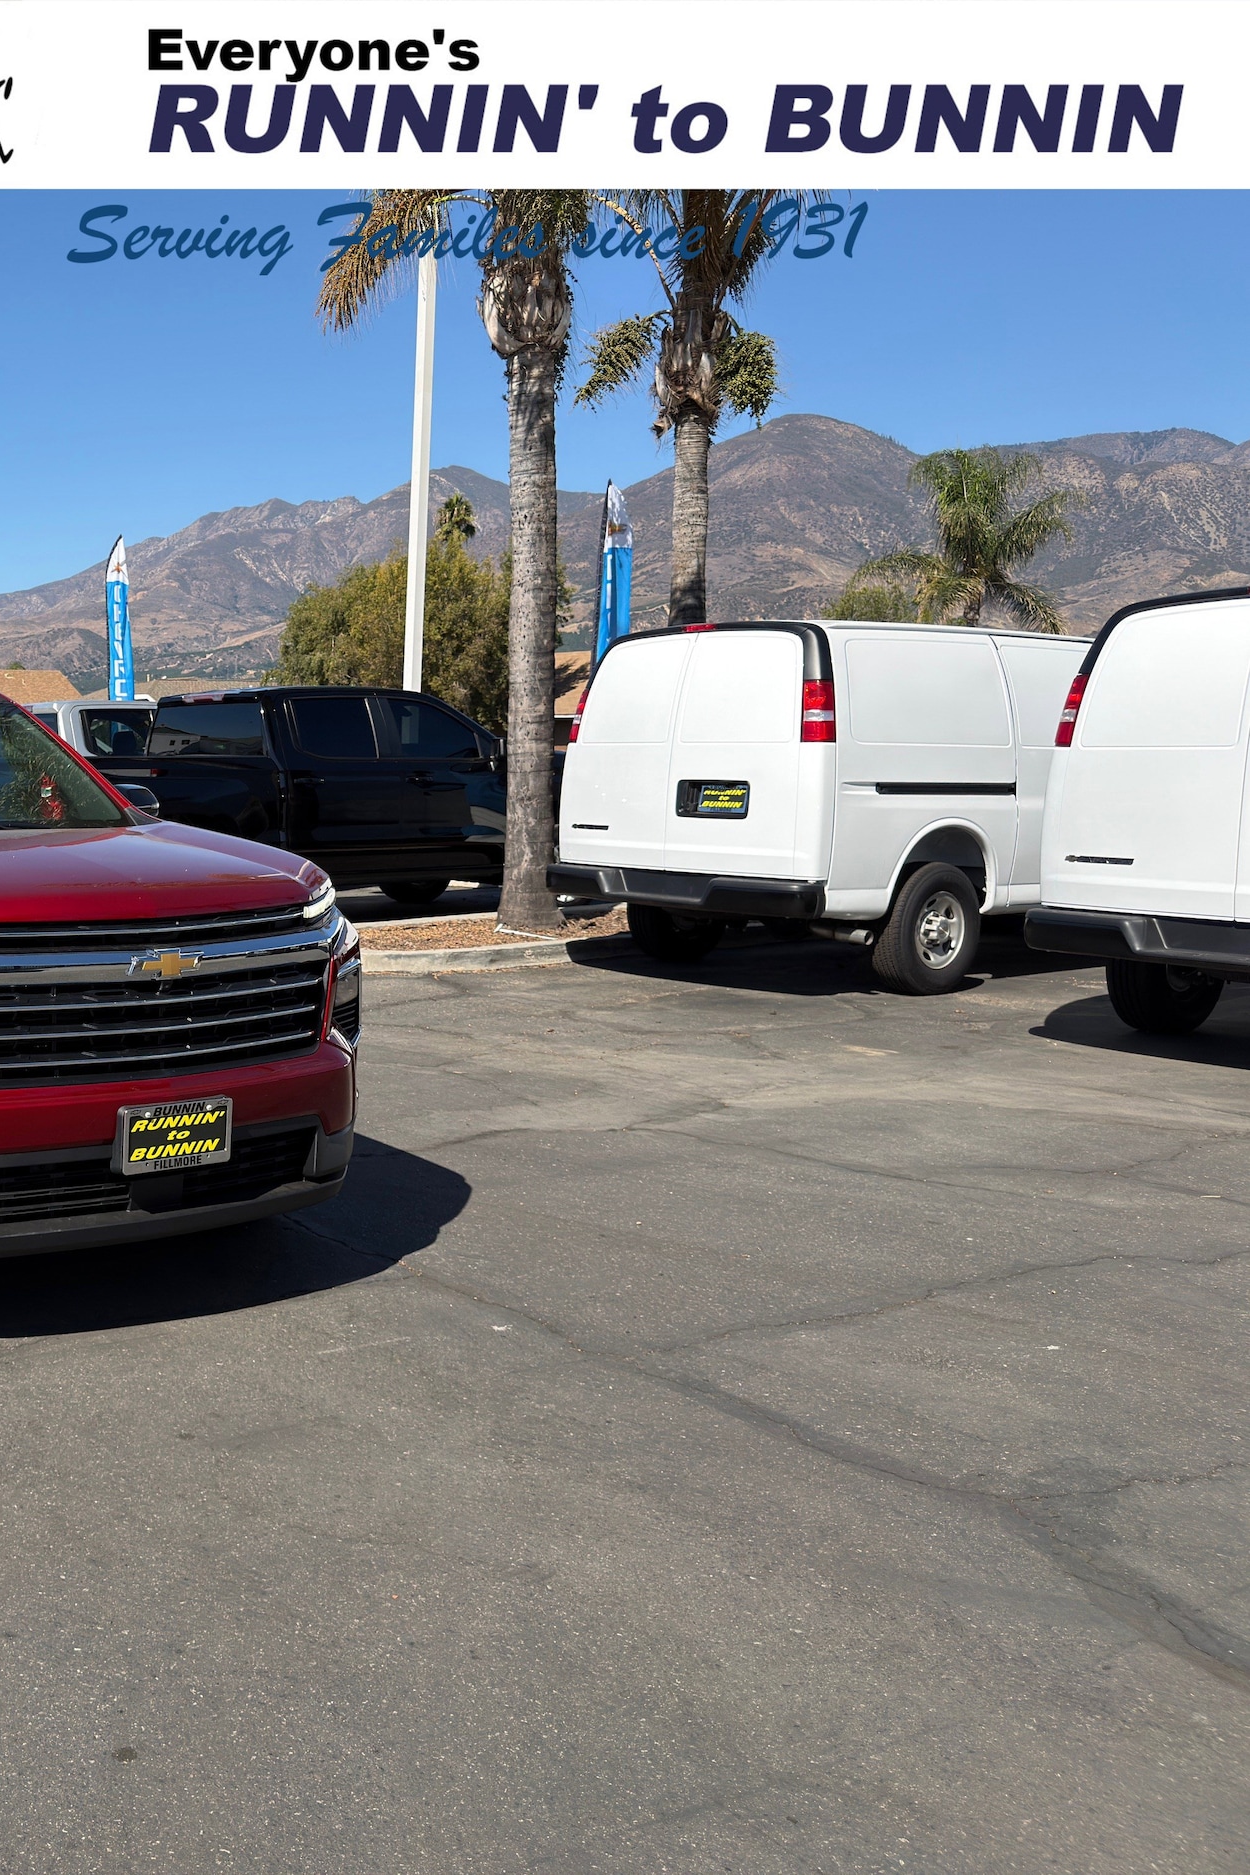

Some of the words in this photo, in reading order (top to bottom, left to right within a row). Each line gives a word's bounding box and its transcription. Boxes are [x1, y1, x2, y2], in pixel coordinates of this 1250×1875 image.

[153, 1101, 207, 1117] BUNNIN
[130, 1110, 226, 1133] RUNNIN'
[166, 1130, 191, 1141] to
[129, 1138, 221, 1162] BUNNIN
[153, 1154, 203, 1171] FILLMORE
